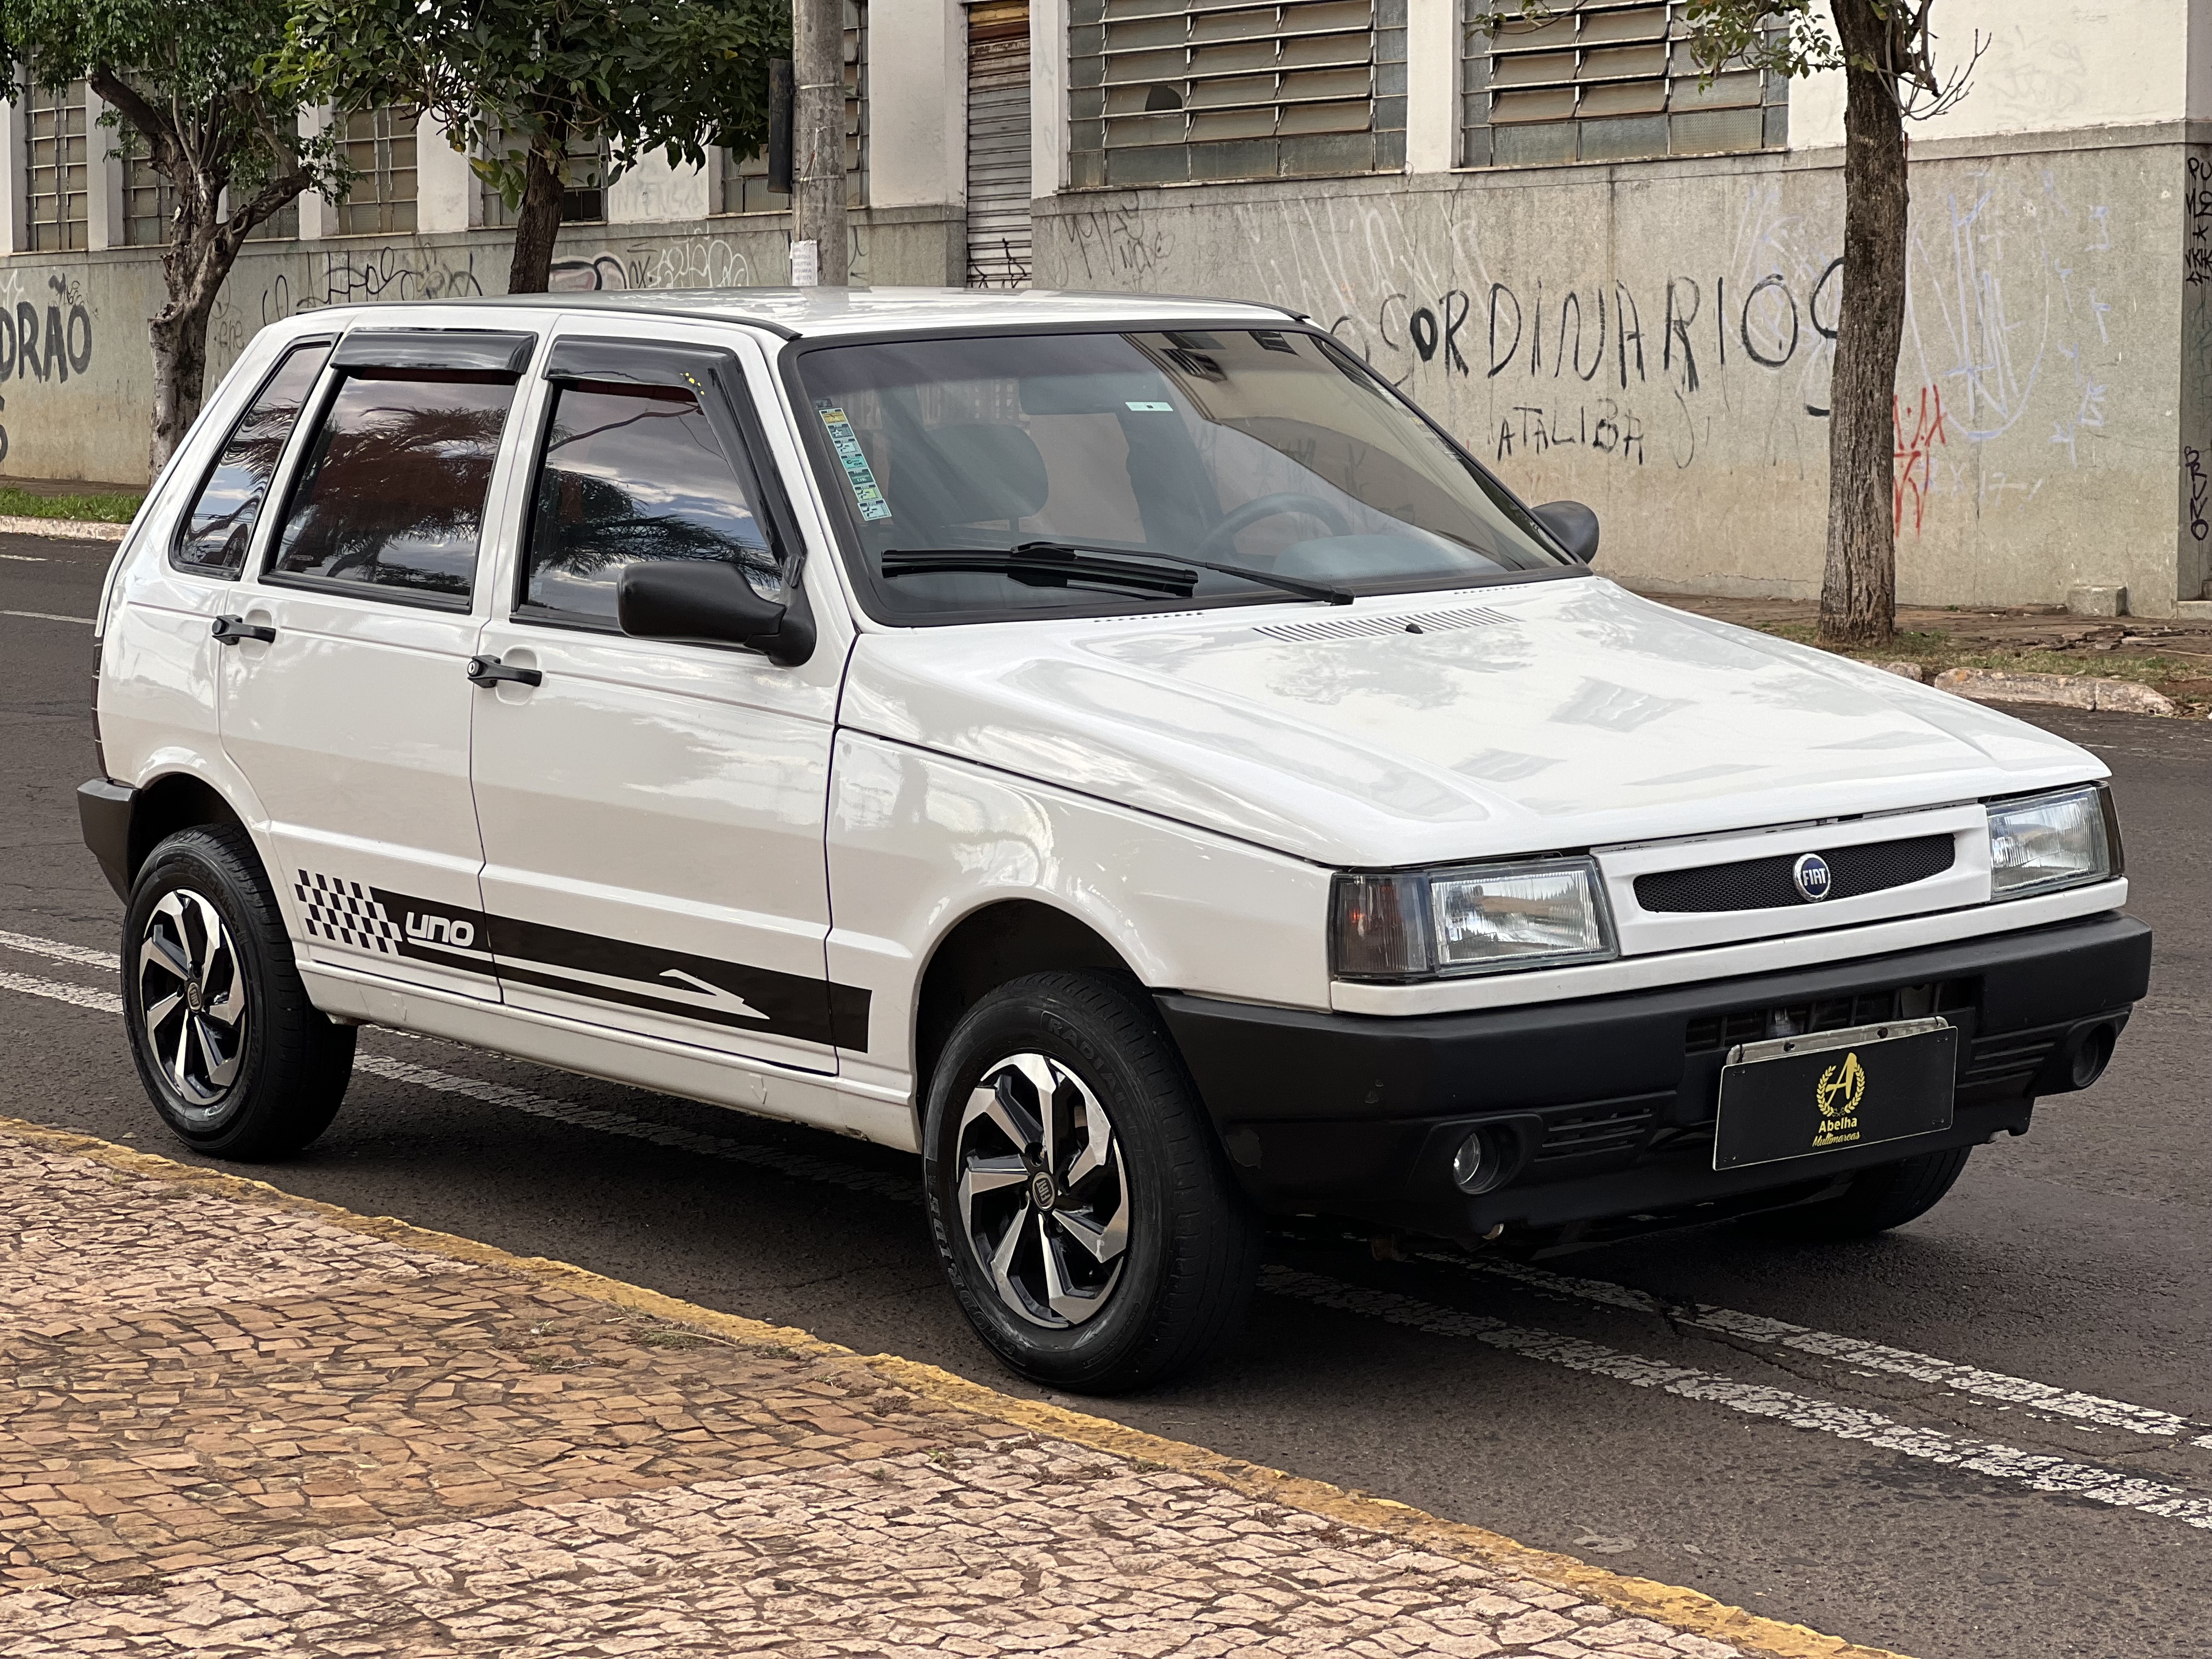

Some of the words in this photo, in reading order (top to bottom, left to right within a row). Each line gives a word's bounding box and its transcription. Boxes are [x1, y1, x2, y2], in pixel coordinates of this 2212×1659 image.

[1498, 397, 1644, 466] ATALIBA
[1802, 868, 1826, 887] FIAT
[190, 989, 199, 1005] FIAT
[1818, 1116, 1858, 1133] Abelha
[1812, 1131, 1861, 1148] Multimarcas
[1036, 1180, 1051, 1202] FIAT
